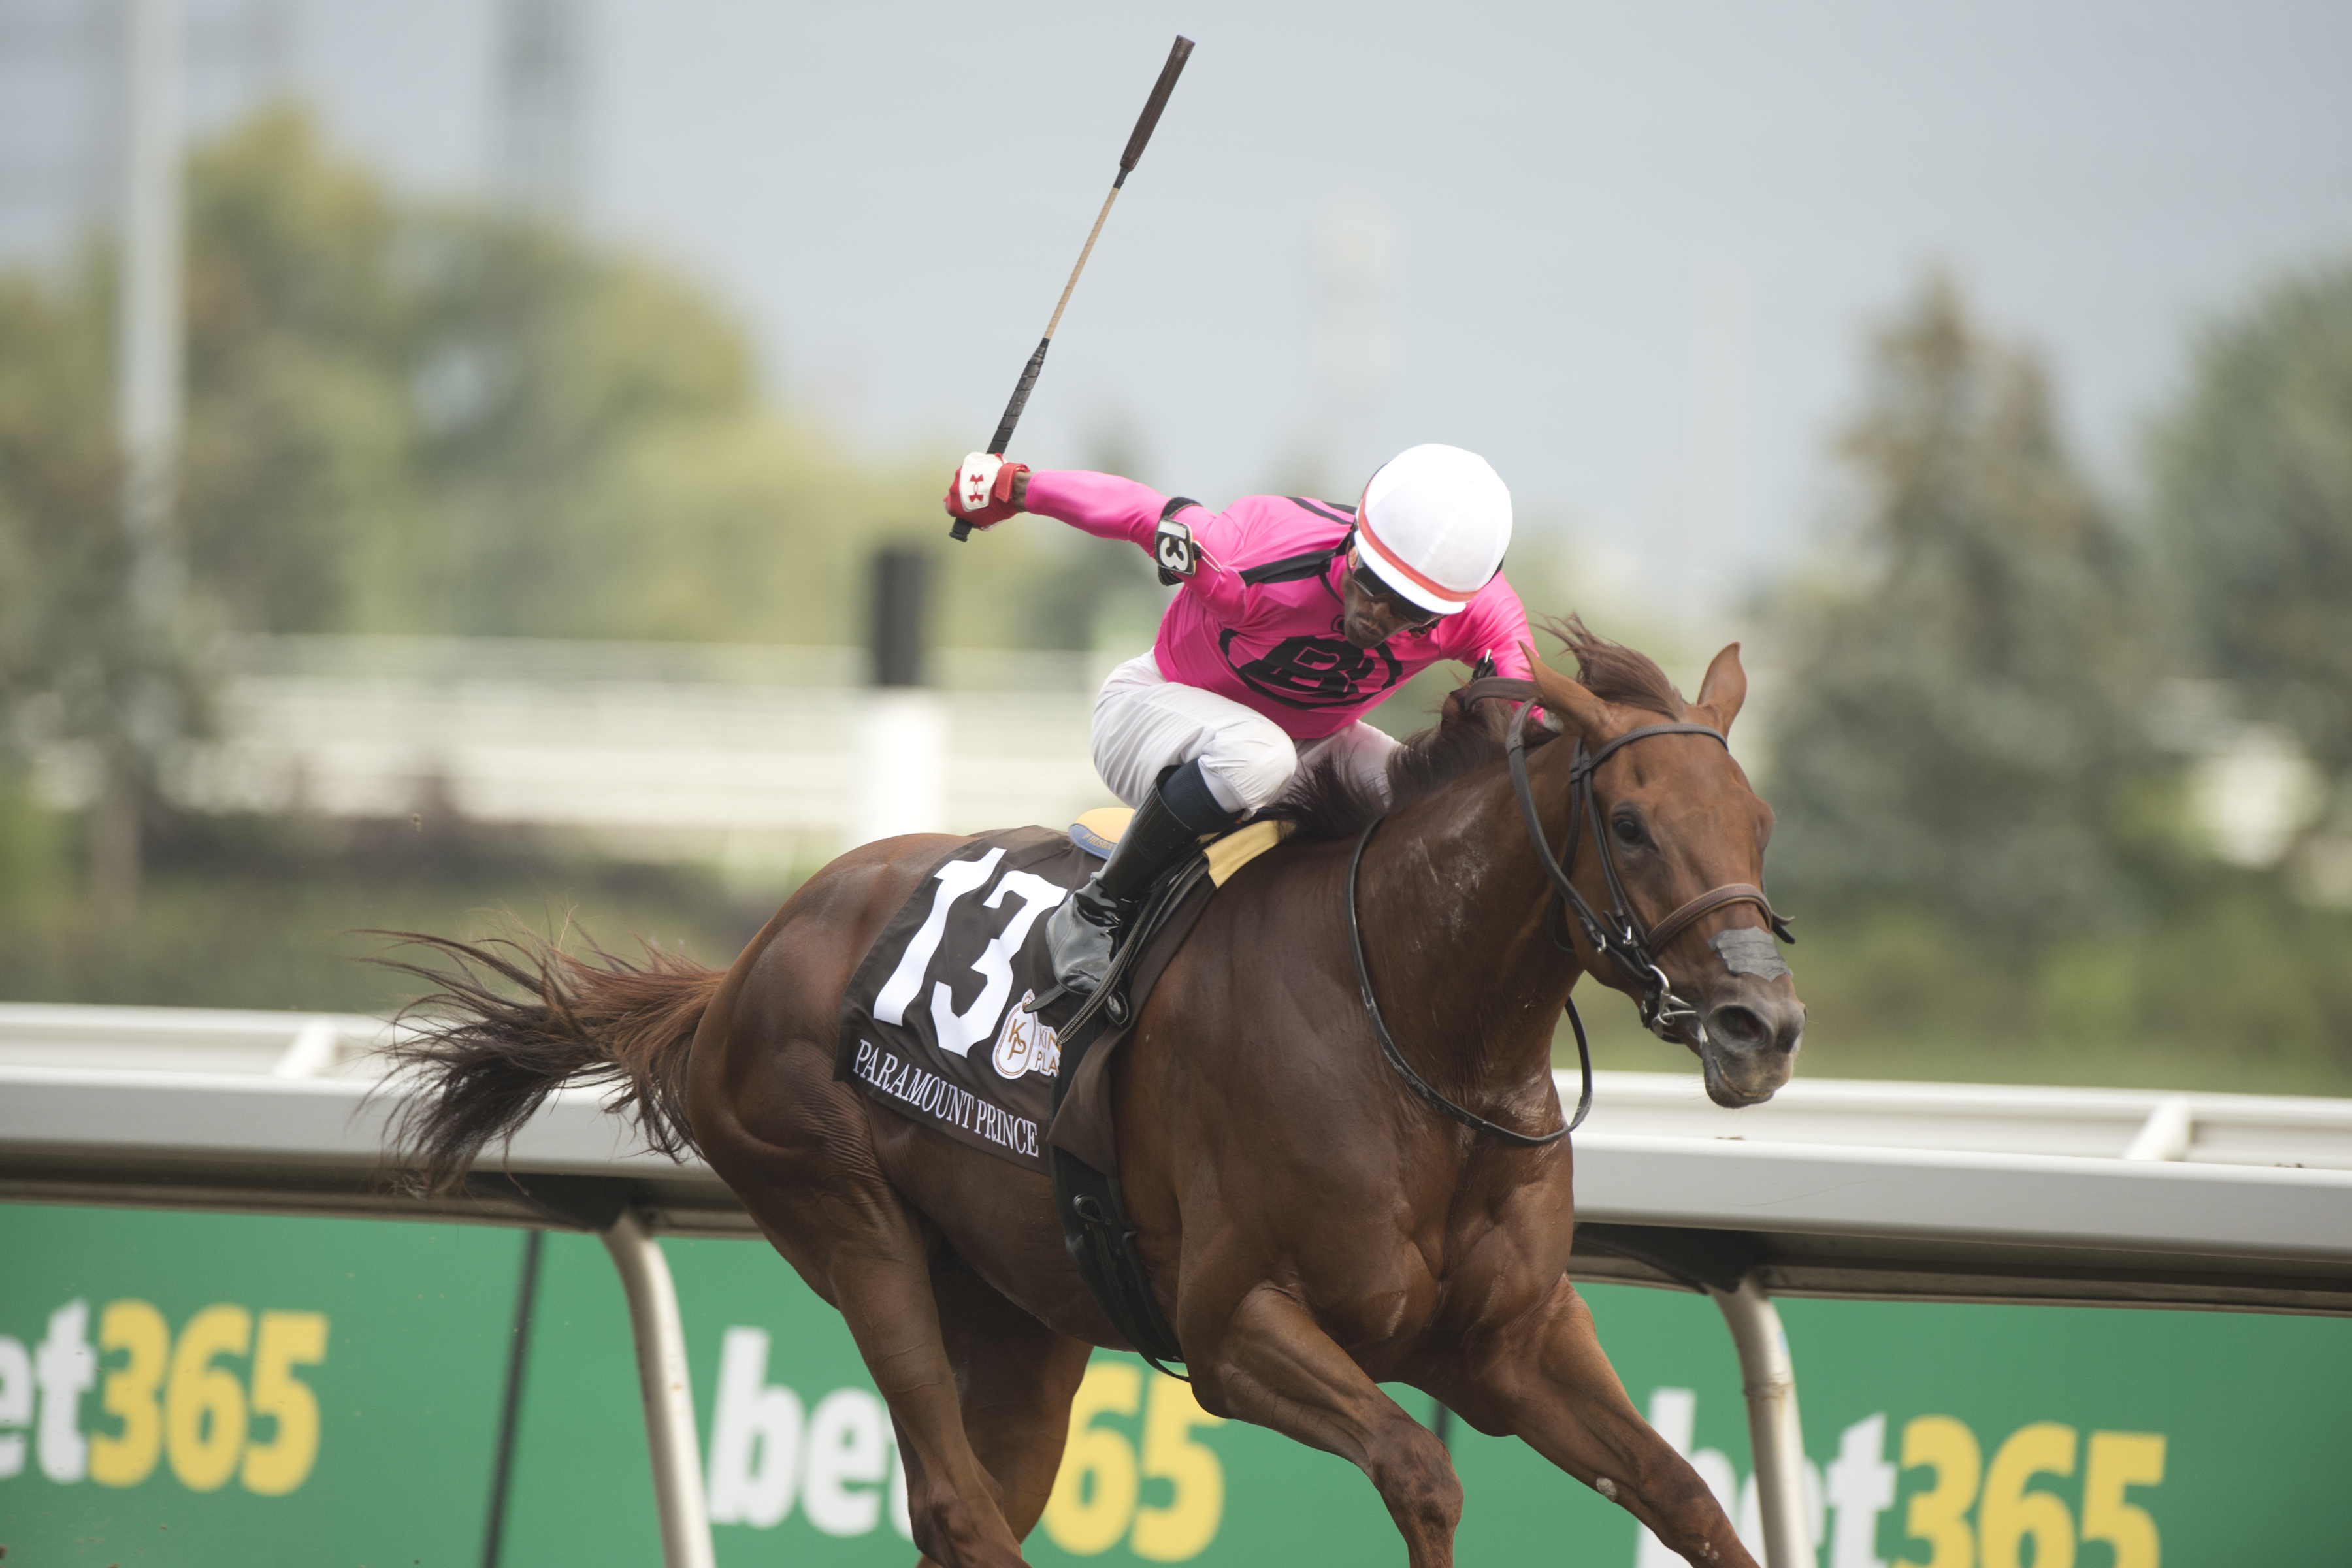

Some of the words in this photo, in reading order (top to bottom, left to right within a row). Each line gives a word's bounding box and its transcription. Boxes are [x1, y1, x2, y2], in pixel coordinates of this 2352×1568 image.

[1157, 519, 1189, 572] 13
[1087, 836, 1115, 851] HUSBA
[873, 847, 1068, 1058] 13
[852, 1039, 975, 1129] PARAMOUNT
[973, 1099, 1039, 1158] PRINCE
